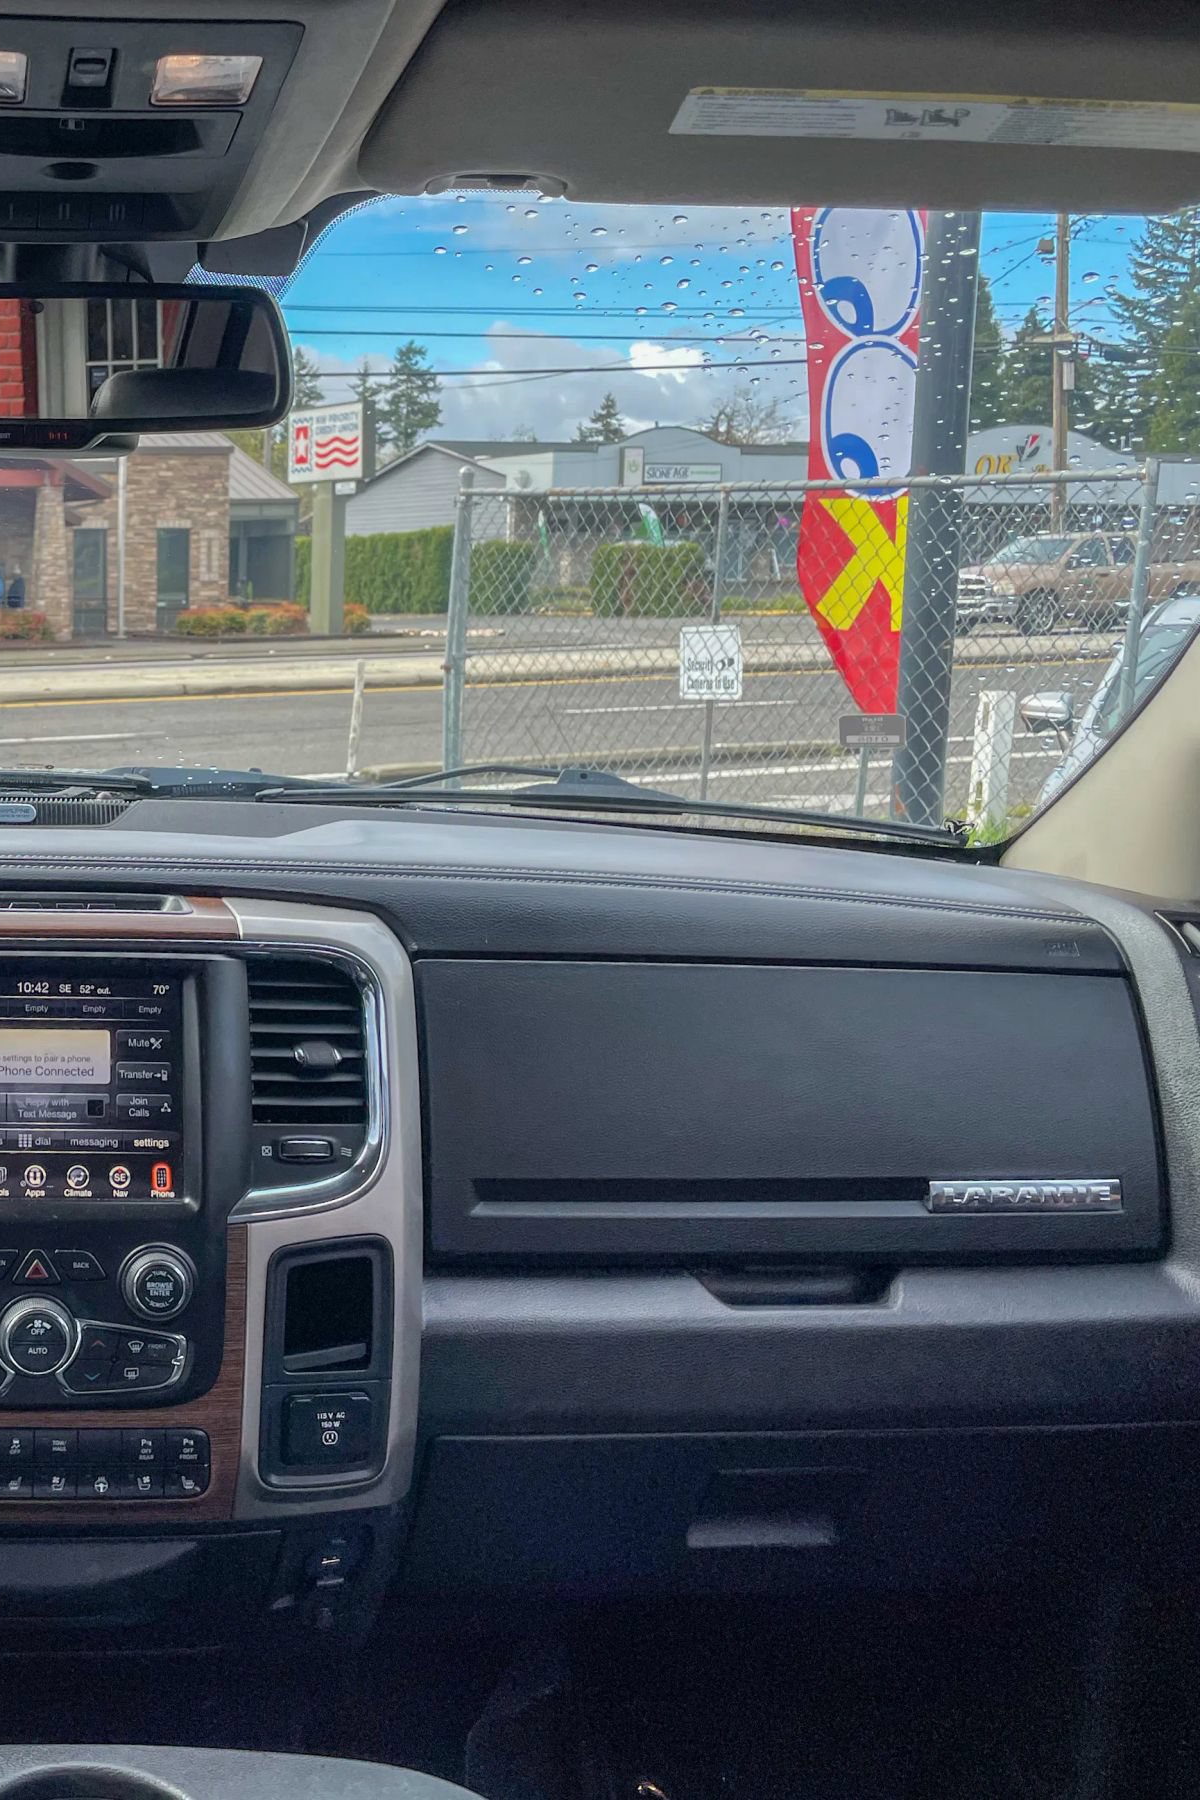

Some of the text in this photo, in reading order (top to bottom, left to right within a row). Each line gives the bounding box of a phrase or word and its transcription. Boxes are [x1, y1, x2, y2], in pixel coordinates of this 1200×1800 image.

[315, 421, 359, 434] CREDIT UNION
[17, 982, 49, 993] 10:42
[59, 984, 72, 993] SE
[80, 984, 95, 994] 52°
[153, 985, 170, 995] 70°
[25, 1004, 49, 1013] Empty
[82, 1004, 106, 1014] Empty
[138, 1005, 162, 1015] Empty
[128, 1038, 150, 1048] Mute
[2, 1054, 33, 1063] settings
[34, 1054, 42, 1062] to
[43, 1055, 58, 1063] pair
[35, 1066, 95, 1077] Connected
[119, 1069, 154, 1079] Transfer
[25, 1099, 69, 1108] Reply with
[130, 1097, 148, 1105] Join
[18, 1110, 77, 1120] Text Message
[128, 1108, 150, 1117] Calls
[34, 1137, 51, 1146] dial
[70, 1138, 118, 1148] messaging
[133, 1138, 169, 1149] settings
[25, 1188, 46, 1198] Apps
[64, 1189, 92, 1198] Climate
[113, 1189, 129, 1198] Nav
[151, 1190, 175, 1199] Phone
[943, 1185, 1112, 1204] LARAMIE
[150, 1289, 170, 1297] ENTER
